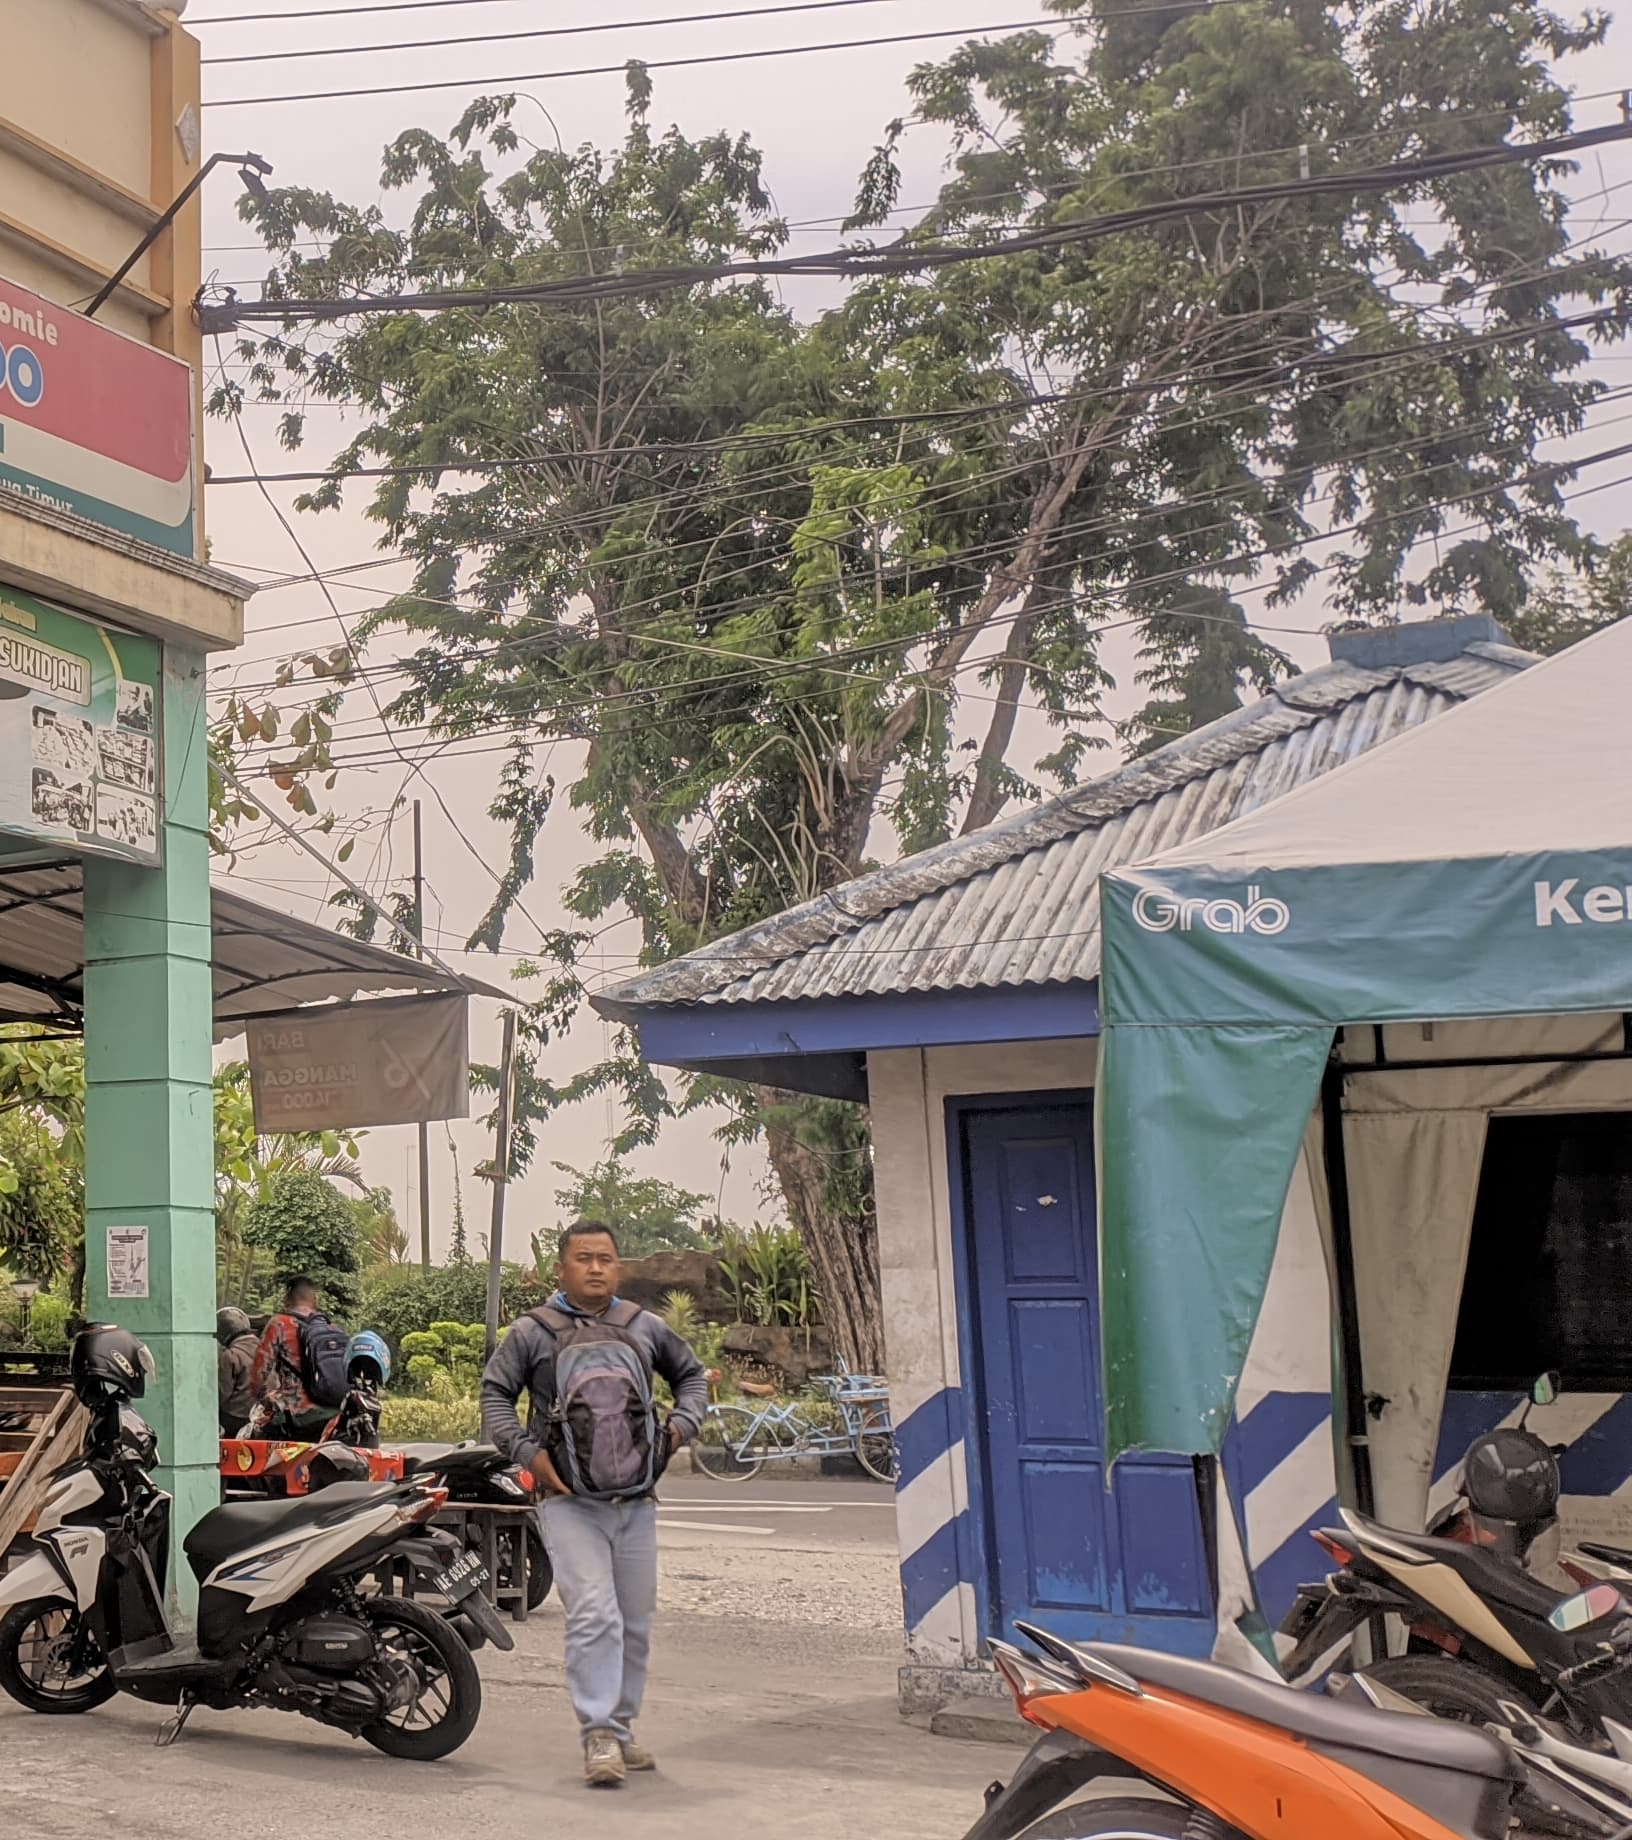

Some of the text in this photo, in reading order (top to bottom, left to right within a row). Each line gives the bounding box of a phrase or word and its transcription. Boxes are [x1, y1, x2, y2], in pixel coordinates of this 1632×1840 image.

[1131, 885, 1291, 936] Grab
[436, 1573, 453, 1591] AE
[448, 1559, 471, 1582] 6926
